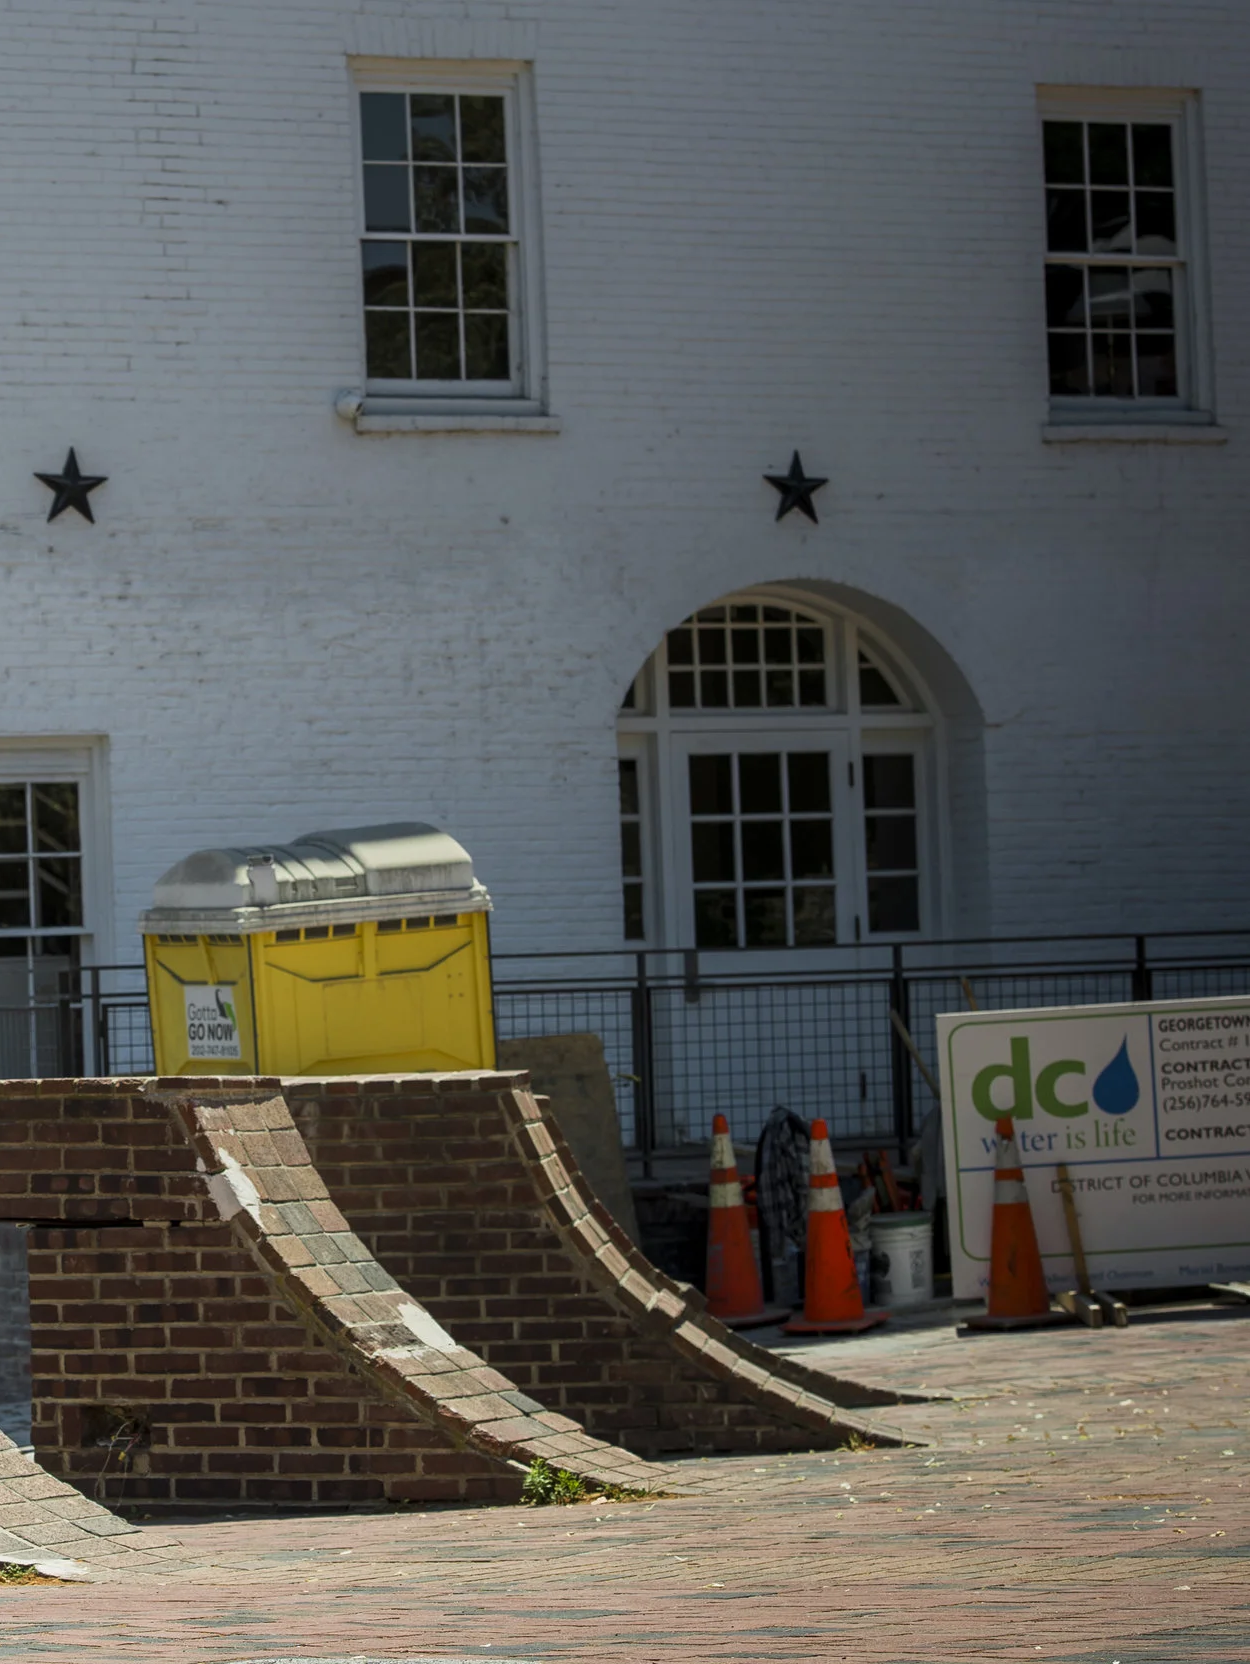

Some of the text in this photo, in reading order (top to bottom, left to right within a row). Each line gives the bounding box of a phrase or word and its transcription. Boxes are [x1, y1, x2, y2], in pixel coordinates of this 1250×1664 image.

[187, 1003, 217, 1021] Gotta
[188, 1023, 233, 1041] GO NOW
[1159, 1037, 1224, 1052] Contract
[1228, 1035, 1238, 1048] #
[971, 1036, 1089, 1122] dc
[1161, 1075, 1220, 1092] Proshot
[980, 1117, 1137, 1154] wter is life
[1165, 1124, 1250, 1141] CONTRAC
[1051, 1176, 1124, 1194] DSTRICT
[1129, 1174, 1152, 1189] OF
[1156, 1168, 1242, 1187] COLUMBIA
[1132, 1193, 1155, 1205] FOR
[1159, 1190, 1192, 1203] MORE
